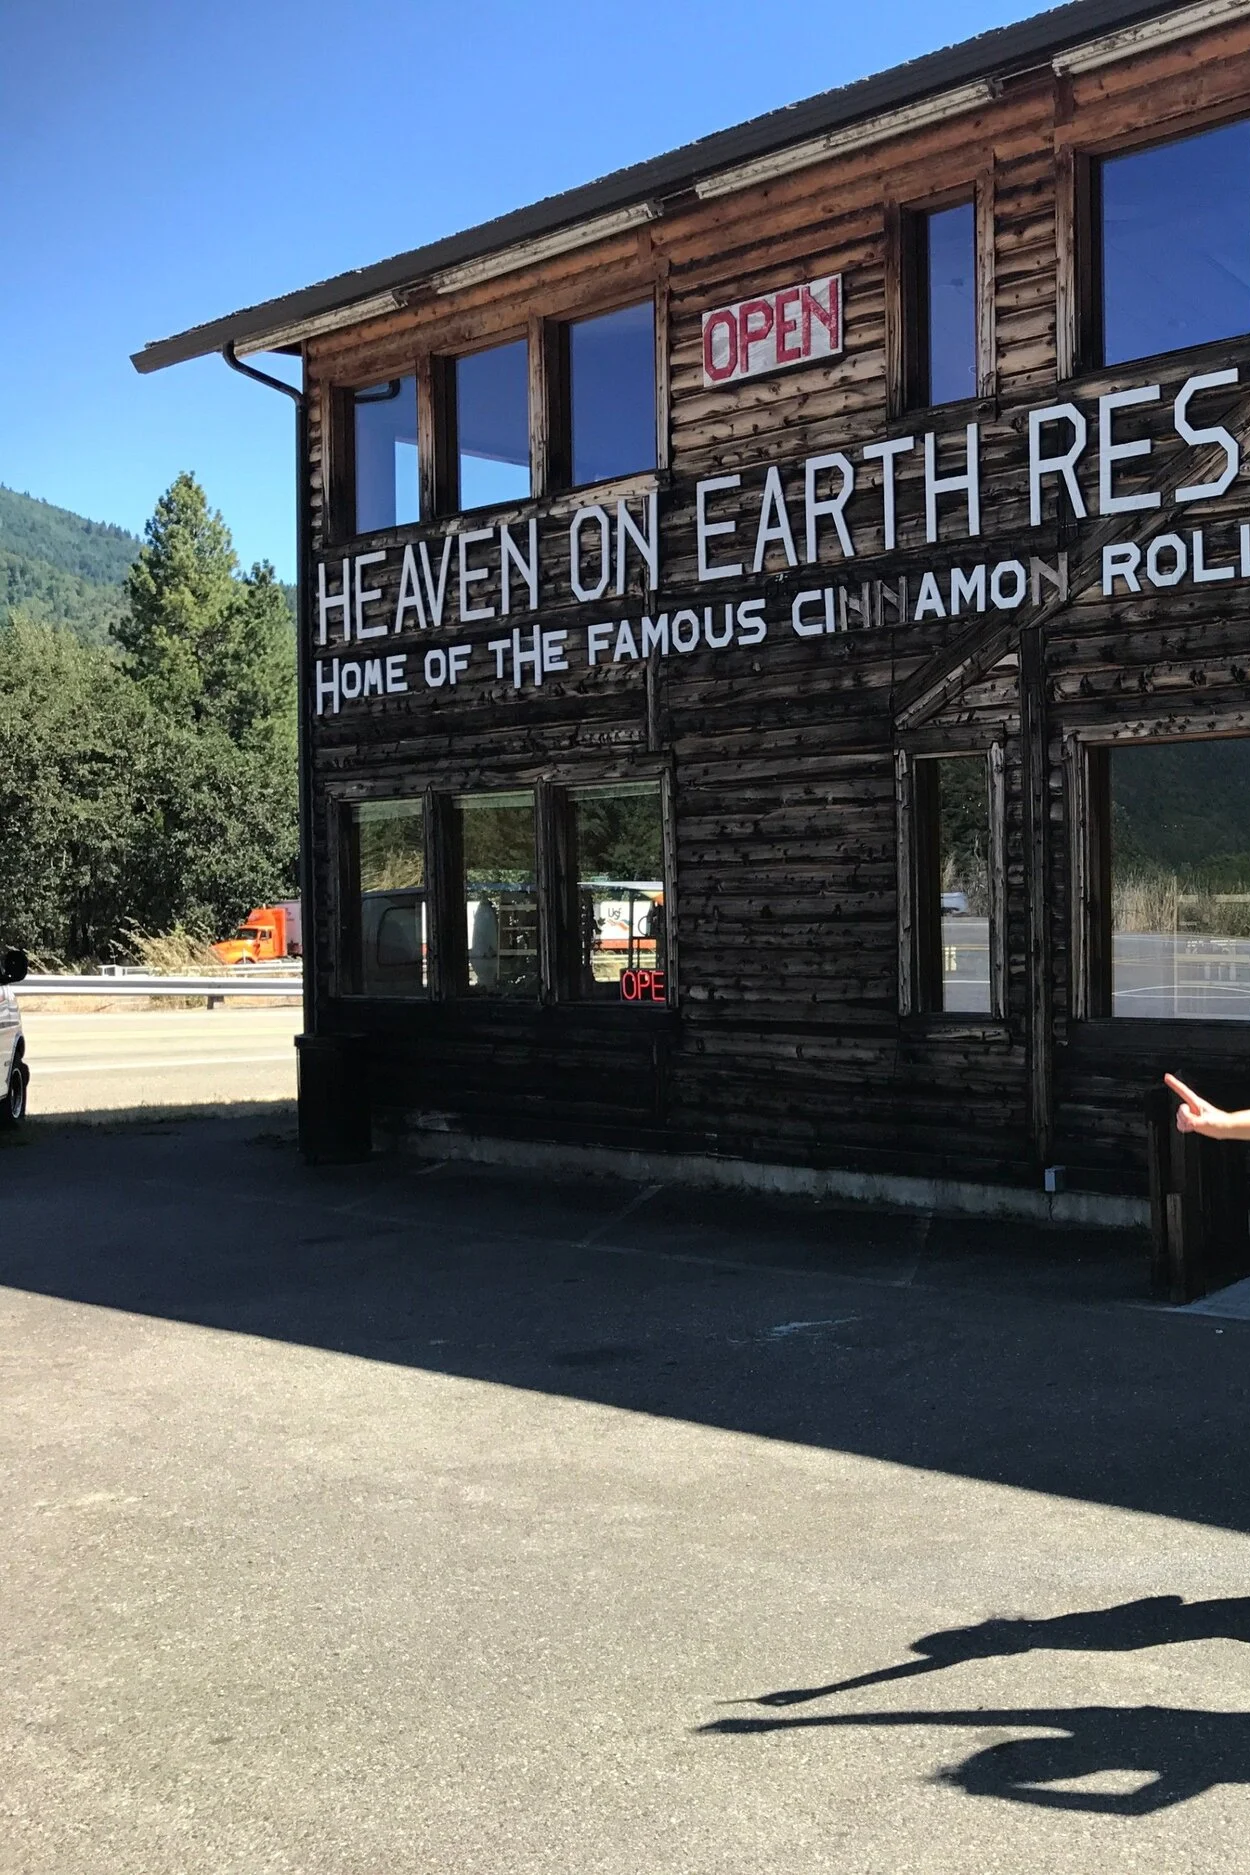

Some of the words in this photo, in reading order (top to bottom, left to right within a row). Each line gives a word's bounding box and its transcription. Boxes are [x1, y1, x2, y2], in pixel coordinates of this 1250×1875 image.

[702, 276, 840, 382] OPEN
[318, 517, 540, 645] HEAVEN
[570, 491, 659, 602] ON
[696, 422, 981, 582] EARTH
[316, 653, 408, 715] HOME
[424, 644, 473, 688] OF
[488, 624, 569, 688] THE
[588, 598, 767, 667] FAMOUS
[792, 552, 1069, 637] CINNAMON
[622, 970, 666, 1003] OPE
